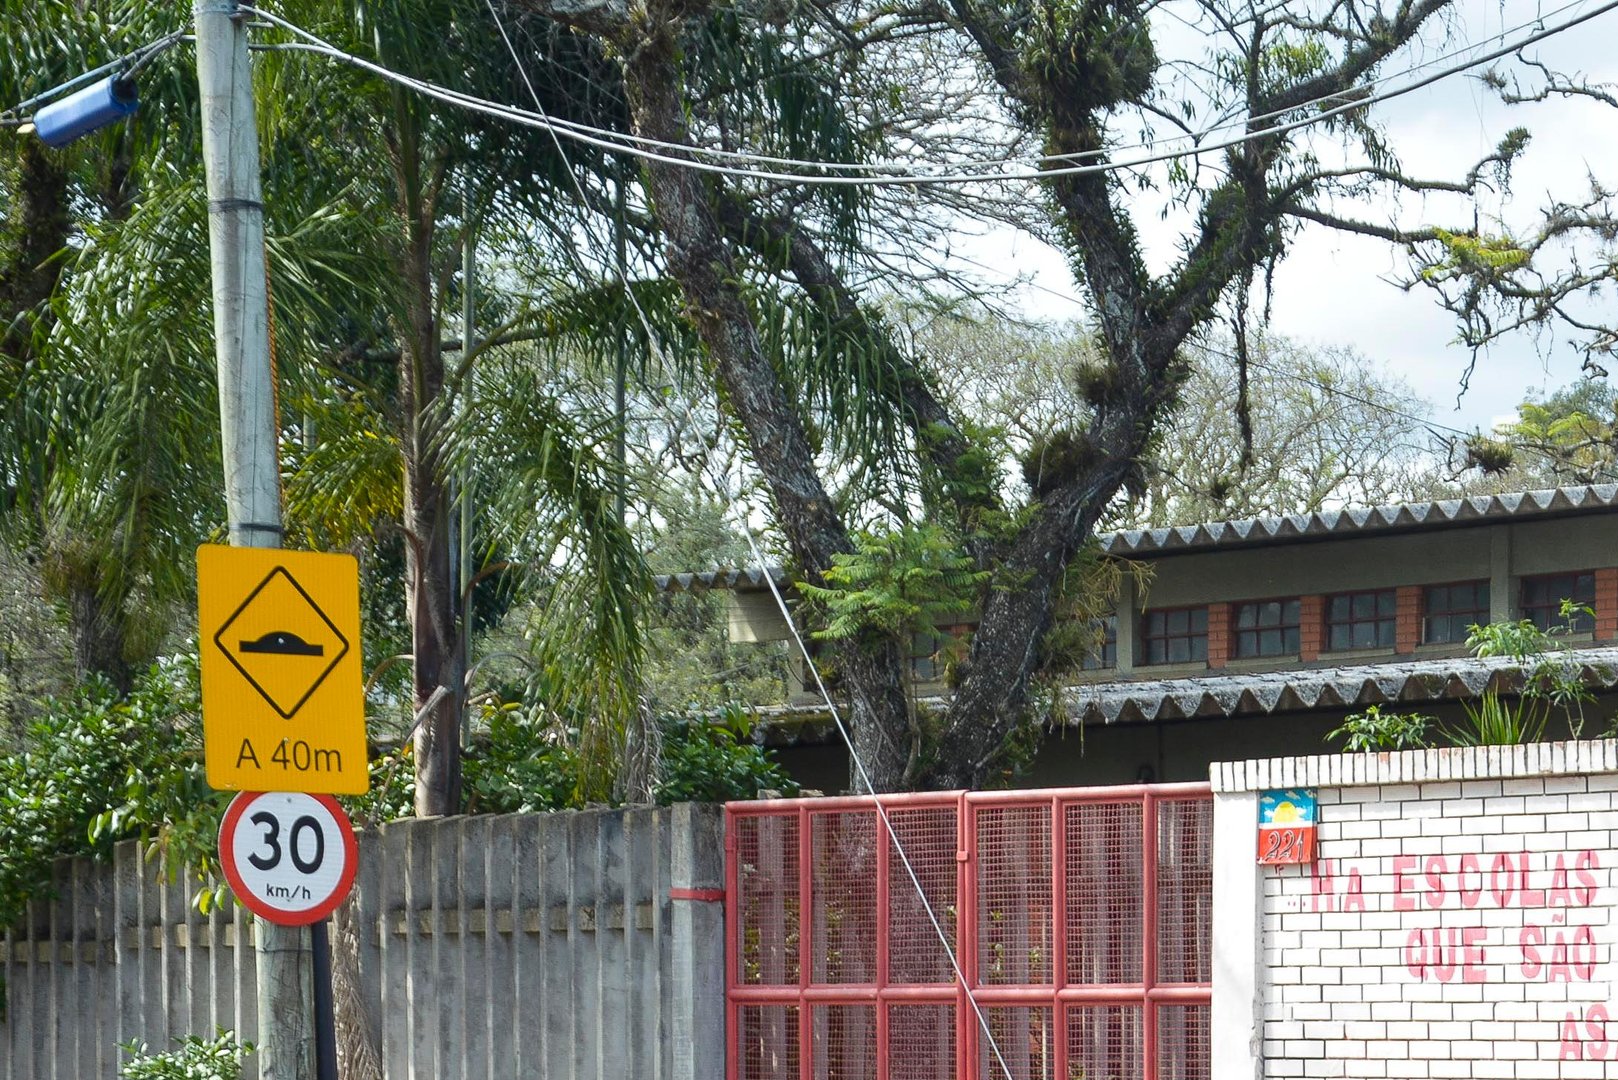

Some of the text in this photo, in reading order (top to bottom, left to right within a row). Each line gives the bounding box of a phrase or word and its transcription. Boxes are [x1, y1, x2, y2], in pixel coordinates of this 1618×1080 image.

[236, 738, 342, 773] A 40m
[247, 811, 325, 874] 30
[1265, 830, 1304, 862] 221
[266, 883, 311, 900] km/h
[1392, 852, 1599, 912] ESCOLAS
[1405, 914, 1597, 984] QUE SÃO
